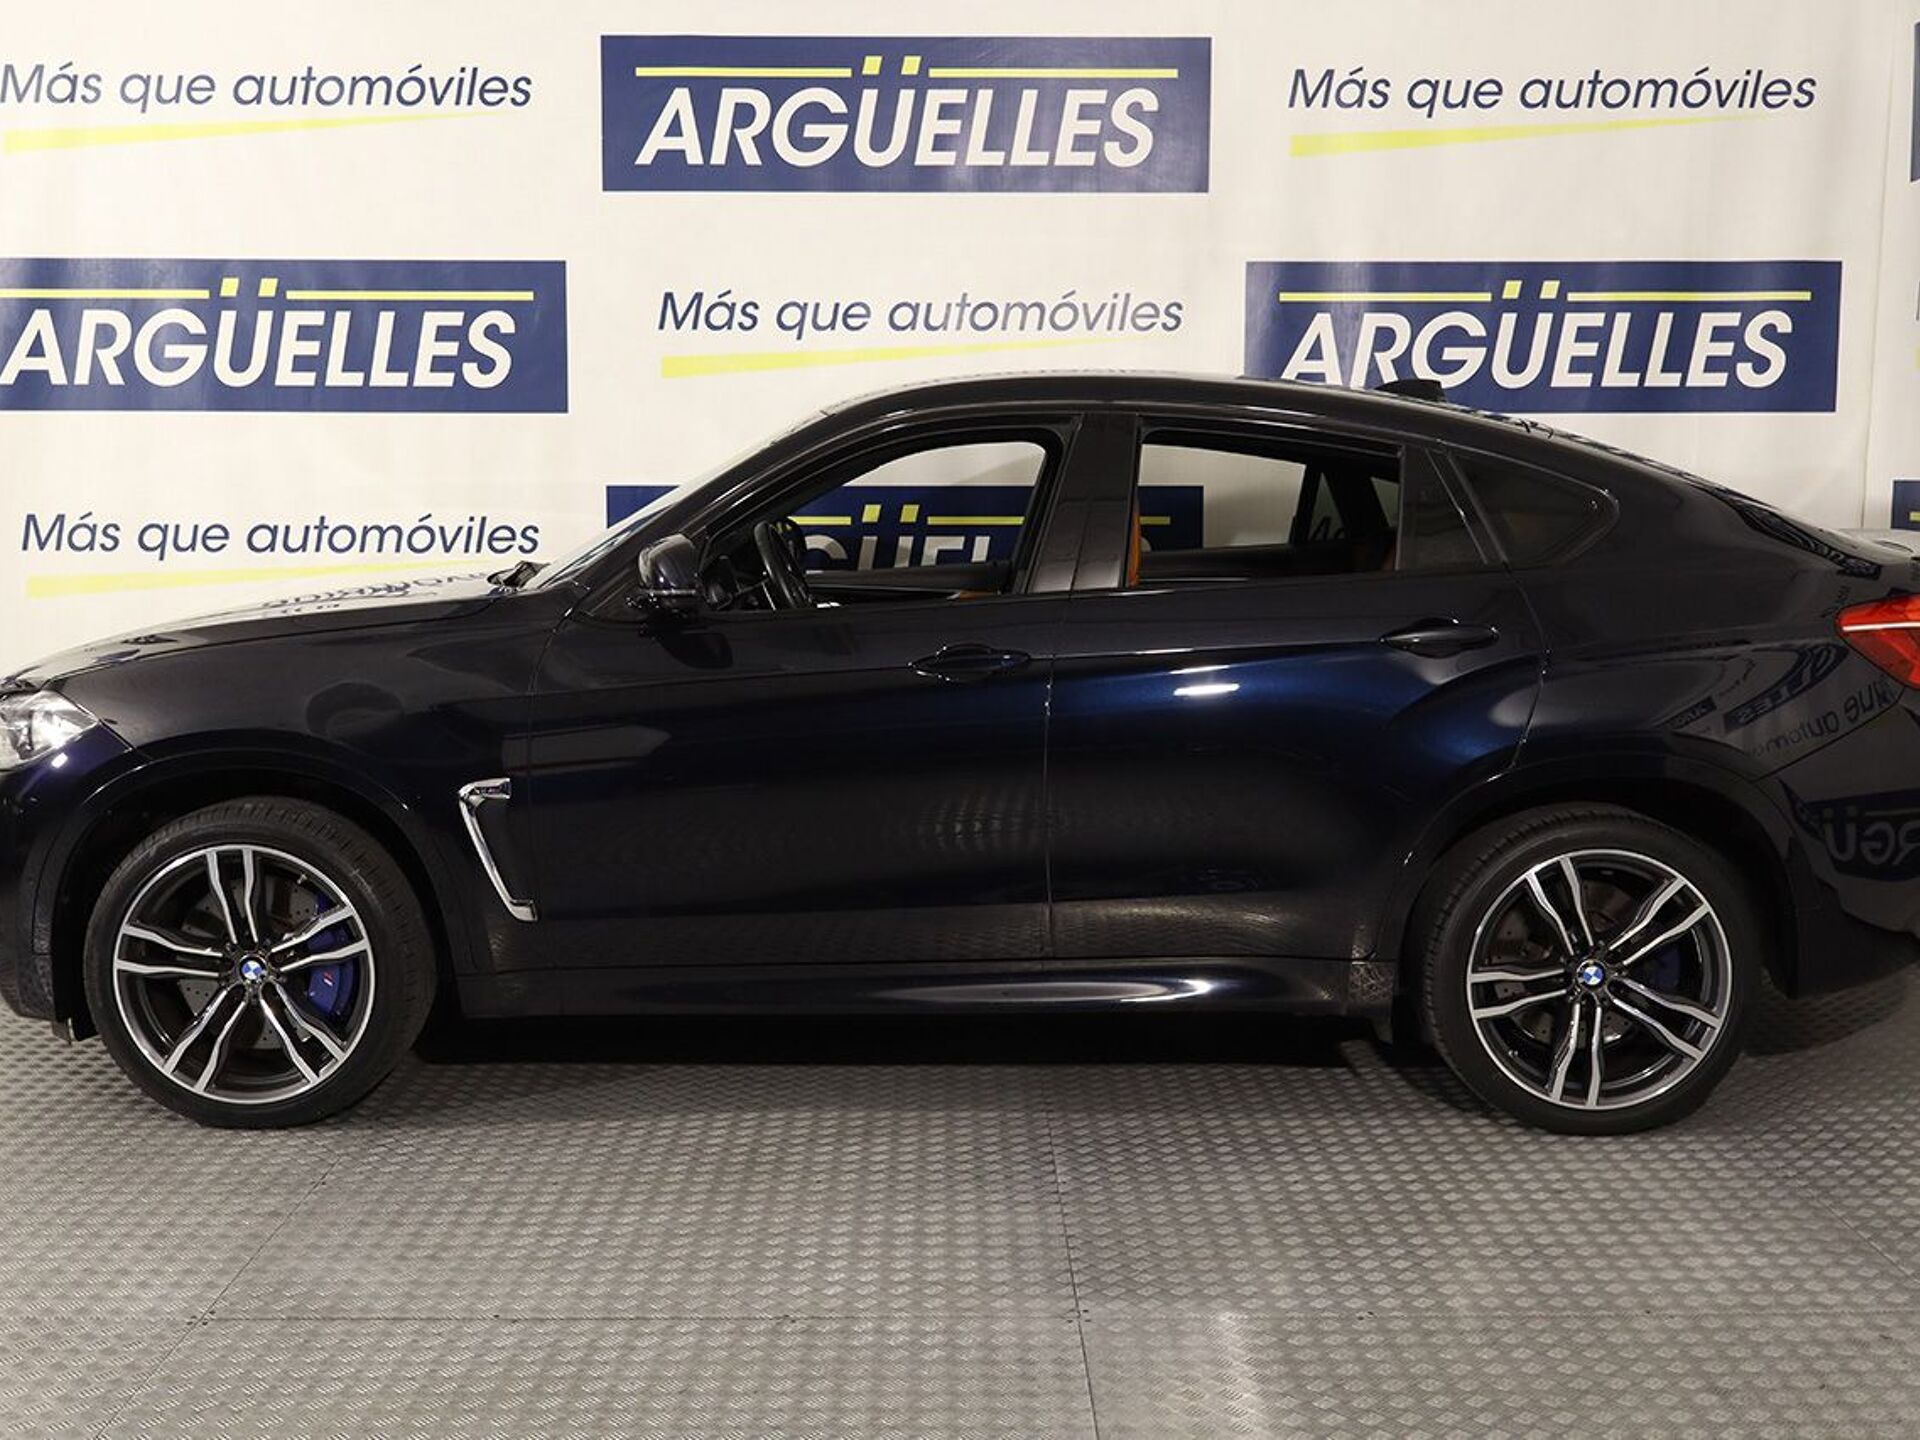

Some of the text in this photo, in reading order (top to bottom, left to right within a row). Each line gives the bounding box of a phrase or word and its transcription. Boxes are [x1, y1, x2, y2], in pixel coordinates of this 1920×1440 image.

[0, 62, 533, 114] Más que automóviles
[634, 55, 1160, 167] ARGÜELLES
[1288, 66, 1817, 119] Más que automóviles
[0, 277, 517, 389] ARGÜELLES
[657, 289, 1184, 341] Más que automóviles
[1279, 279, 1794, 389] ARGÜELLES
[21, 511, 540, 562] Más que automóviles
